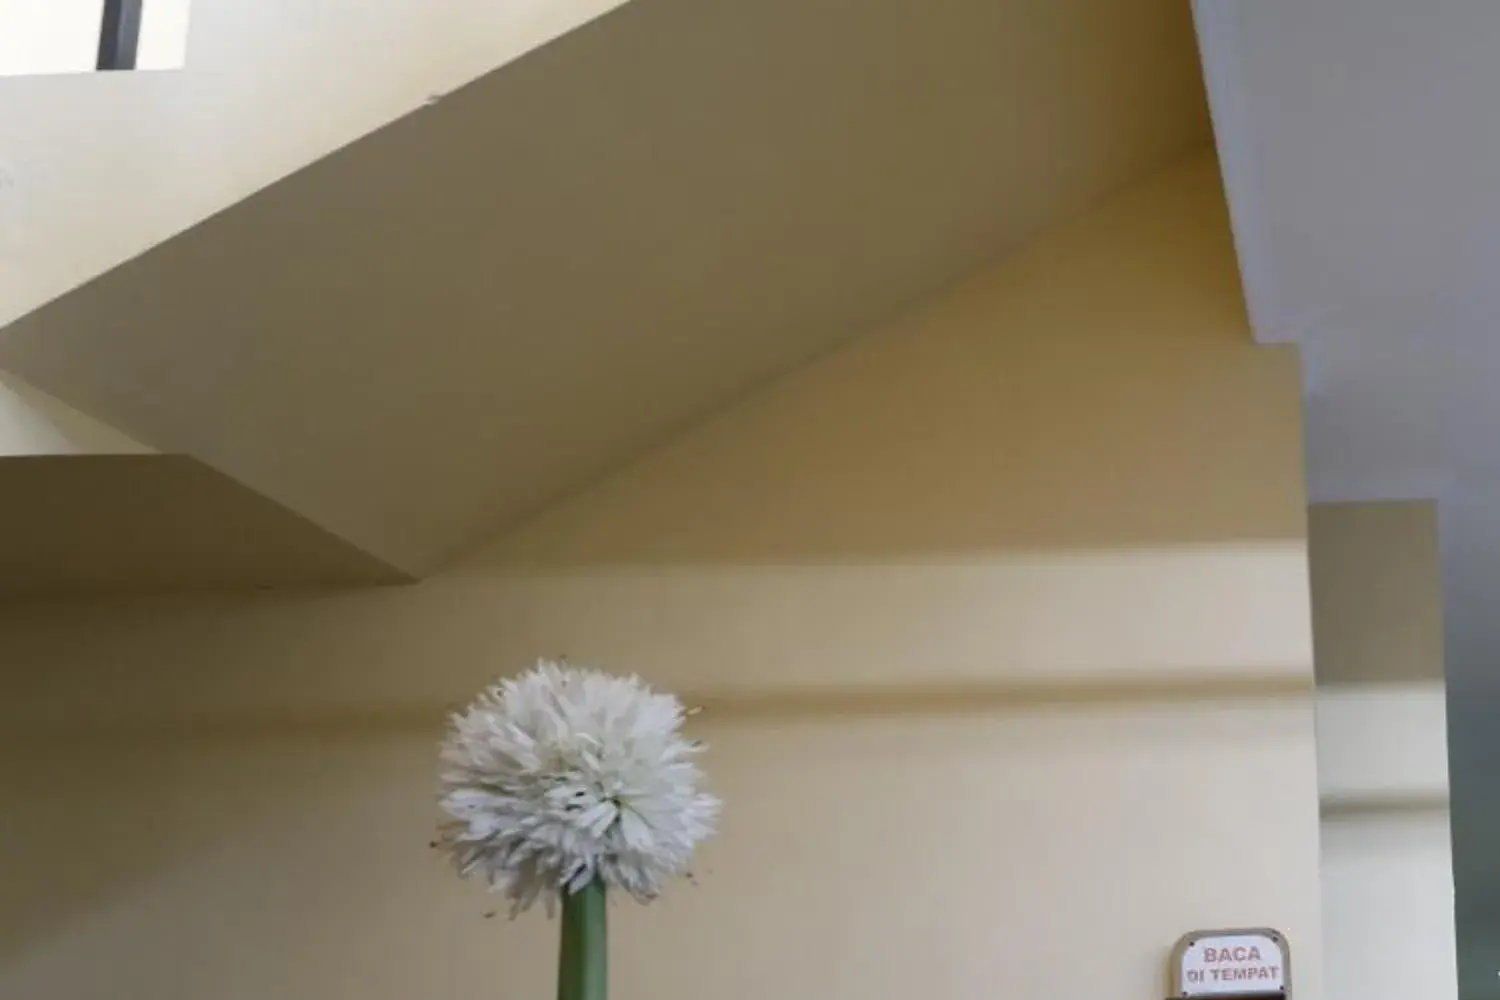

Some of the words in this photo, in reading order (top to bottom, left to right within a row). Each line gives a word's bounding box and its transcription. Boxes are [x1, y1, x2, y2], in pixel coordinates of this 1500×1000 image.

[1204, 947, 1261, 963] BACA
[1187, 971, 1205, 983] DI
[1212, 966, 1280, 982] TEMPAT
